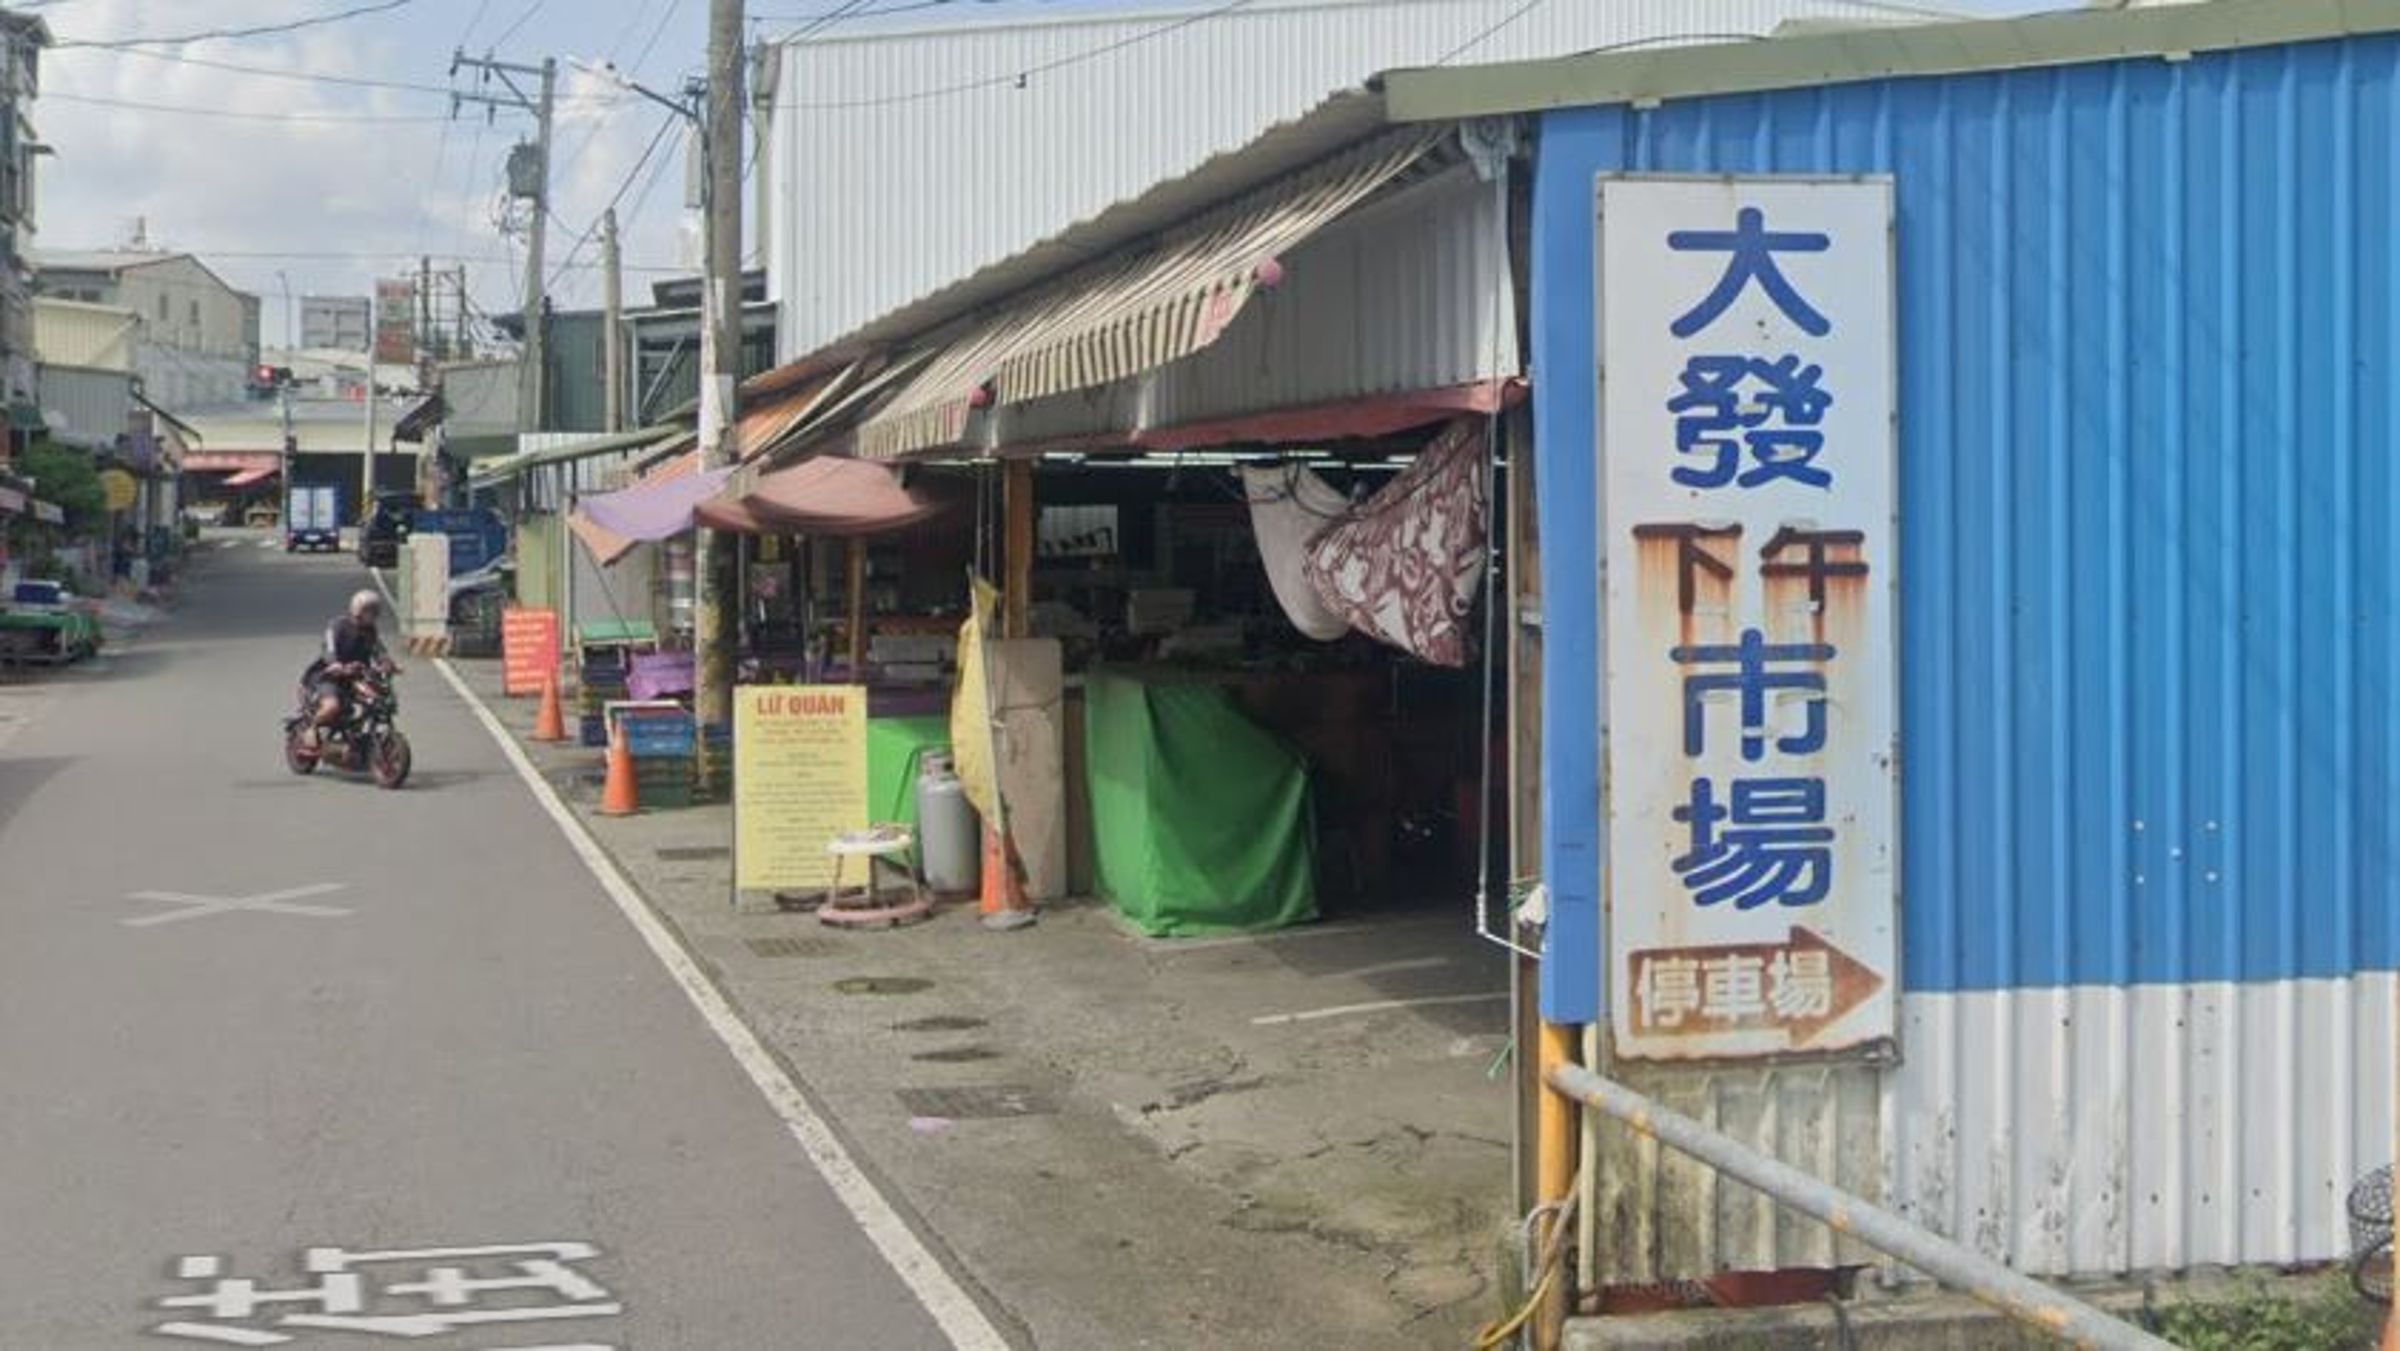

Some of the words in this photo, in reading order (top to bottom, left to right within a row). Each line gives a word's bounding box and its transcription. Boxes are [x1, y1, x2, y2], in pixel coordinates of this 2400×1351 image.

[1667, 206, 1833, 489] 大發
[1632, 522, 1869, 615] 下午
[1669, 627, 1837, 911] 市場
[1635, 950, 1833, 1028] 停車場
